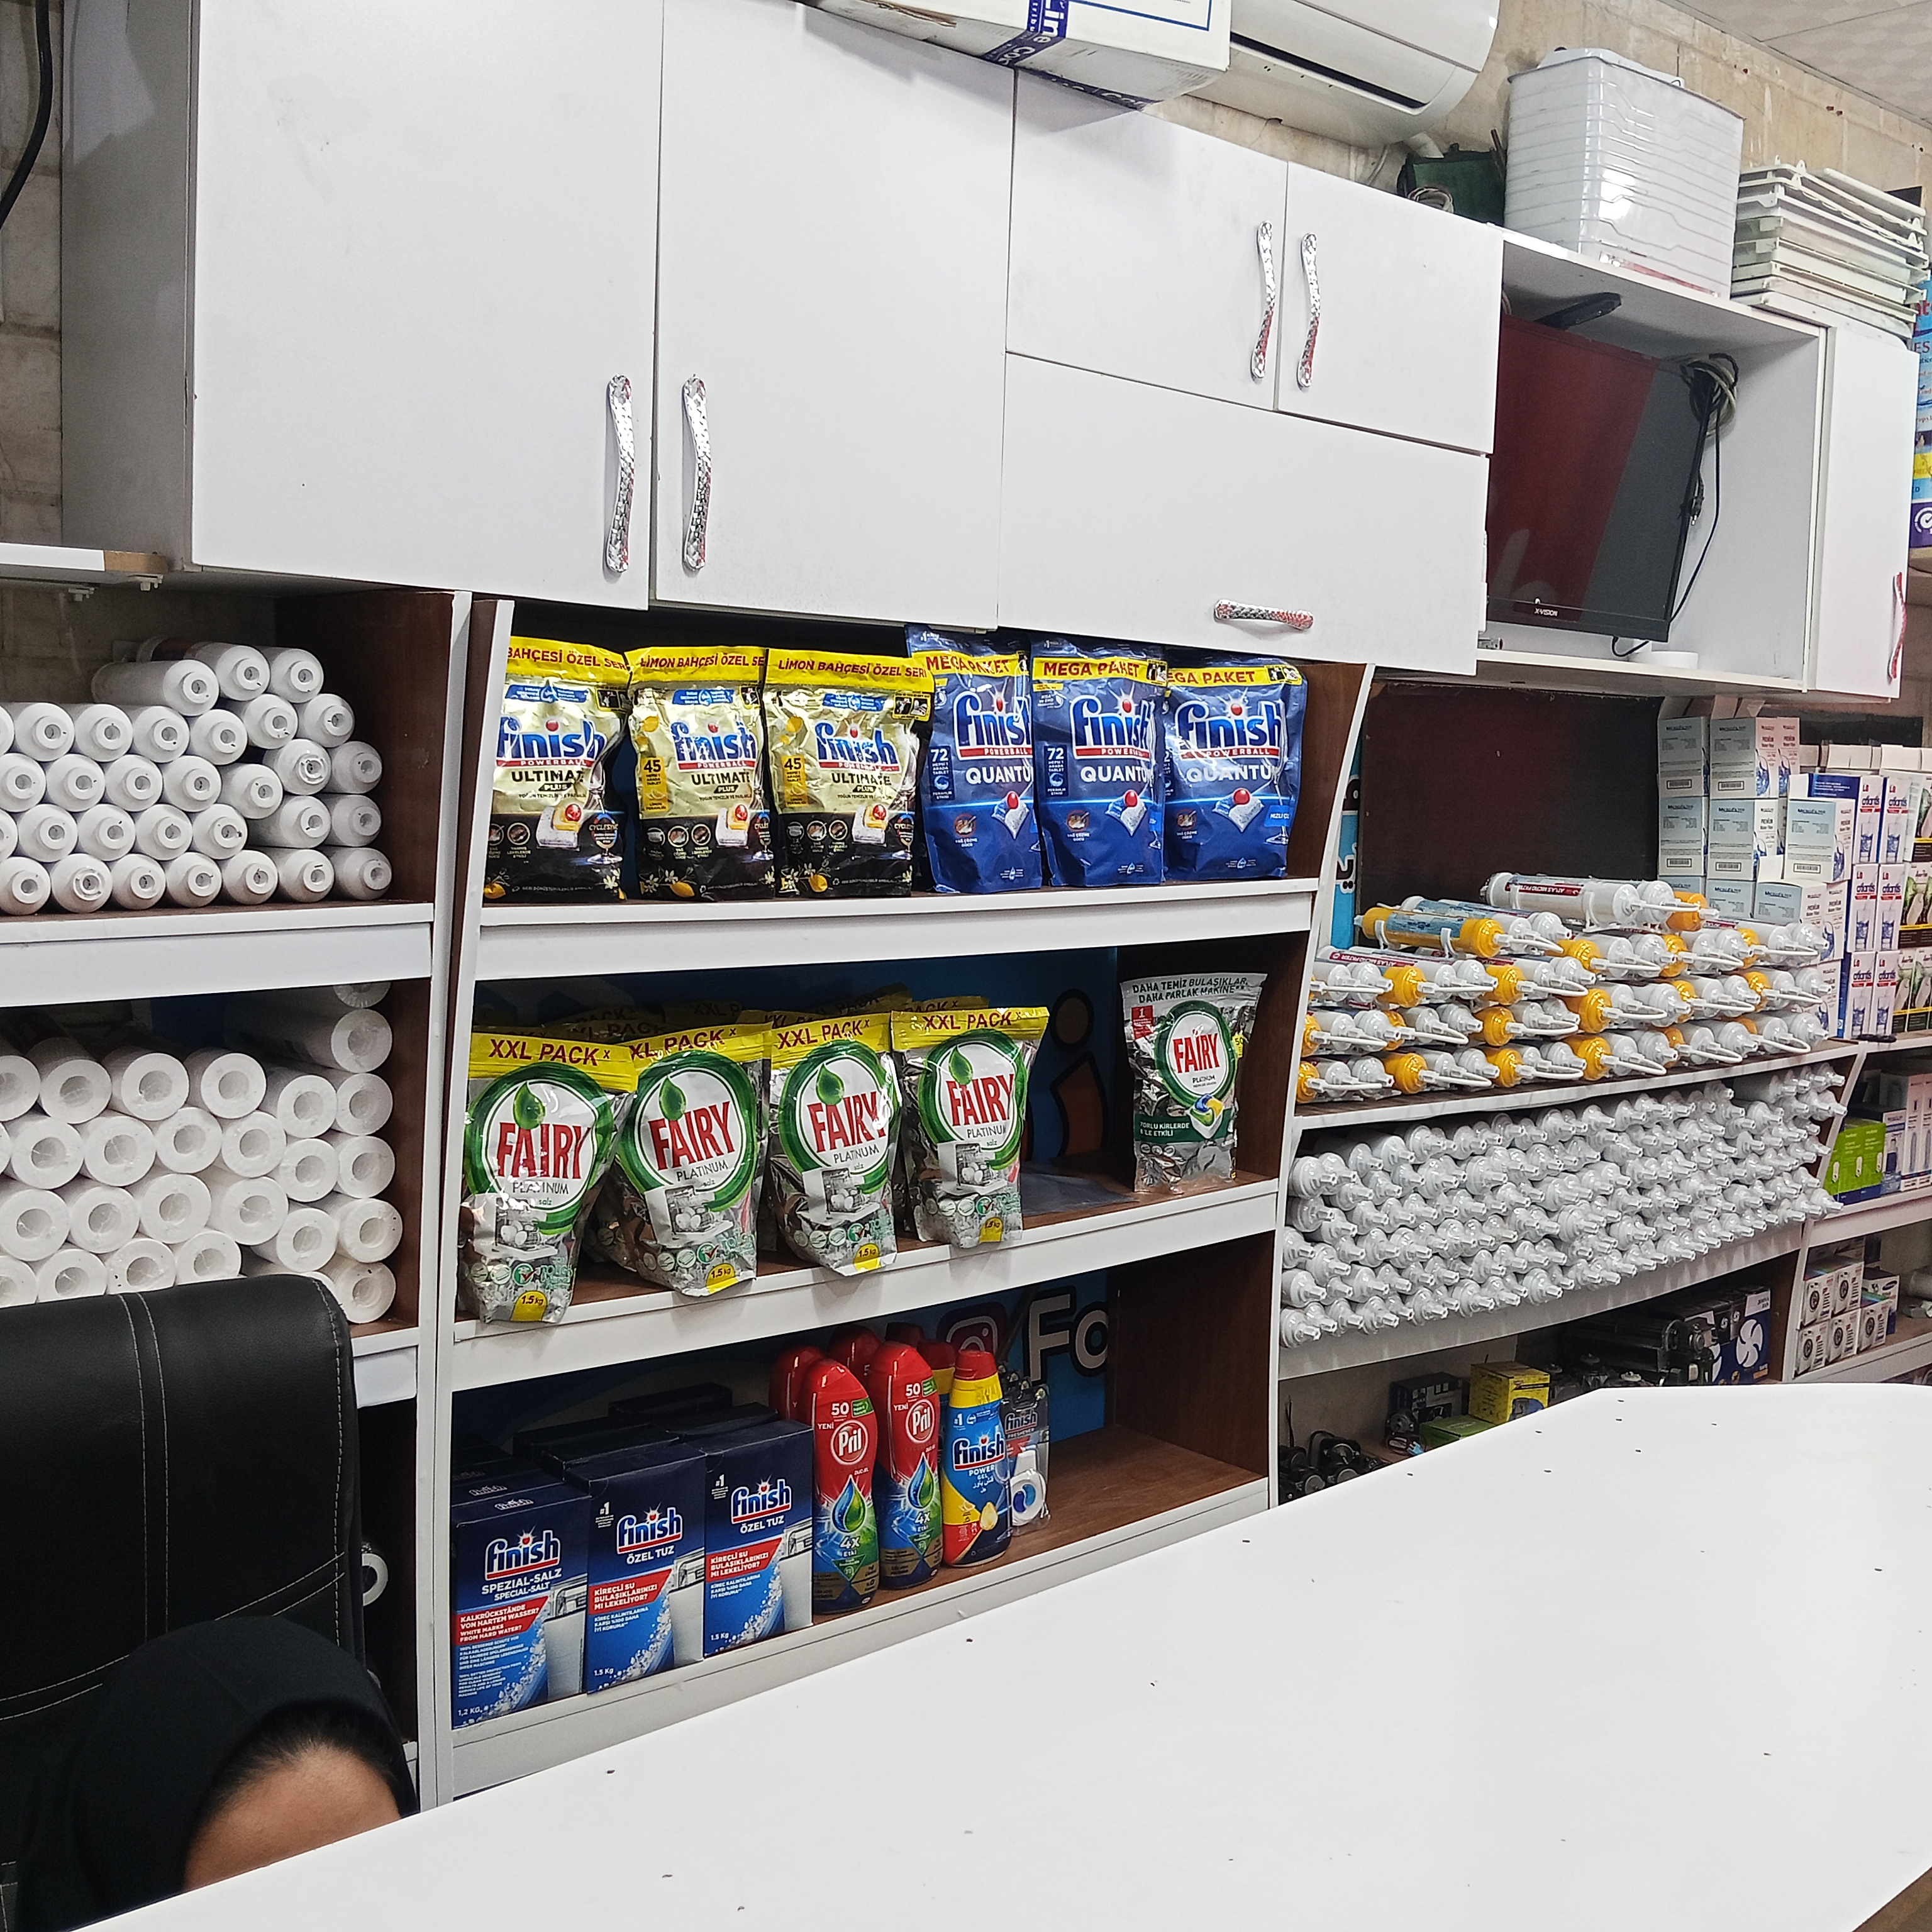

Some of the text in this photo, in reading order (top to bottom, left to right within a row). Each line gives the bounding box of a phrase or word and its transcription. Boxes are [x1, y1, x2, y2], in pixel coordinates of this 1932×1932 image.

[566, 650, 601, 667] ÖZEL
[640, 654, 765, 669] LİMON BAHÇESİ ÖZEL SE
[778, 657, 815, 671] LİMON
[818, 661, 871, 676] BAHÇESİ
[872, 663, 902, 677] ÖZEL
[926, 655, 1010, 677] MEGA PAKET
[1043, 660, 1140, 678] MEGA PAKET
[1168, 670, 1255, 685] EGA PAKET
[1178, 701, 1282, 748] finish
[496, 716, 608, 759] finish
[671, 721, 757, 762] finish
[815, 721, 899, 765] finish
[931, 748, 948, 762] 72
[984, 747, 1028, 756] POWERBALL
[1047, 748, 1064, 760] 72
[1207, 748, 1270, 757] POWERBALL
[644, 759, 661, 773] 45
[697, 760, 747, 769] POWERBALL
[784, 758, 801, 770] 45
[511, 770, 584, 783] ULTIMAT
[543, 783, 568, 791] PLUS
[1132, 982, 1158, 994] DAHA
[1160, 977, 1187, 991] TEMİZ
[1138, 992, 1164, 1004] DAHA
[1165, 988, 1199, 1000] PARLAK
[923, 1011, 1013, 1031] XXL PACK
[1138, 1008, 1146, 1018] 1
[630, 1028, 725, 1061] XL PACK
[777, 1021, 863, 1050] XXL PACK
[489, 1039, 600, 1067] XXL PACK
[1173, 1033, 1221, 1074] FAIRY
[946, 1074, 1015, 1126] FAIRY
[808, 1091, 887, 1153] FAIRY
[648, 1101, 736, 1171] FAIRY
[496, 1122, 591, 1180] FAIRY
[833, 1146, 880, 1164] PLATINUM
[675, 1160, 728, 1182] PLATINUM
[906, 1382, 921, 1397] 50
[831, 1401, 850, 1416] 50
[893, 1402, 909, 1411] YENİ
[817, 1421, 835, 1430] YENİ
[912, 1406, 931, 1436] Pril
[1006, 1408, 1038, 1431] finish
[838, 1427, 862, 1457] Pril
[954, 1431, 1005, 1465] finish
[969, 1465, 995, 1477] POWER
[731, 1479, 791, 1519] finish
[618, 1507, 683, 1549] finish
[740, 1514, 785, 1535] ÖZEL TUZ
[487, 1531, 560, 1572] finish
[626, 1545, 675, 1565] ÖZEL TUZ
[711, 1550, 748, 1564] KİREÇLİ SU
[481, 1567, 562, 1595] SPEZIAL-SALZ
[494, 1581, 551, 1601] SPECIAL-SALT
[594, 1582, 635, 1597] KİREÇLİ SU
[460, 1621, 477, 1629] VON
[508, 1607, 540, 1621] WASSER?
[458, 1708, 469, 1717] 1,2
